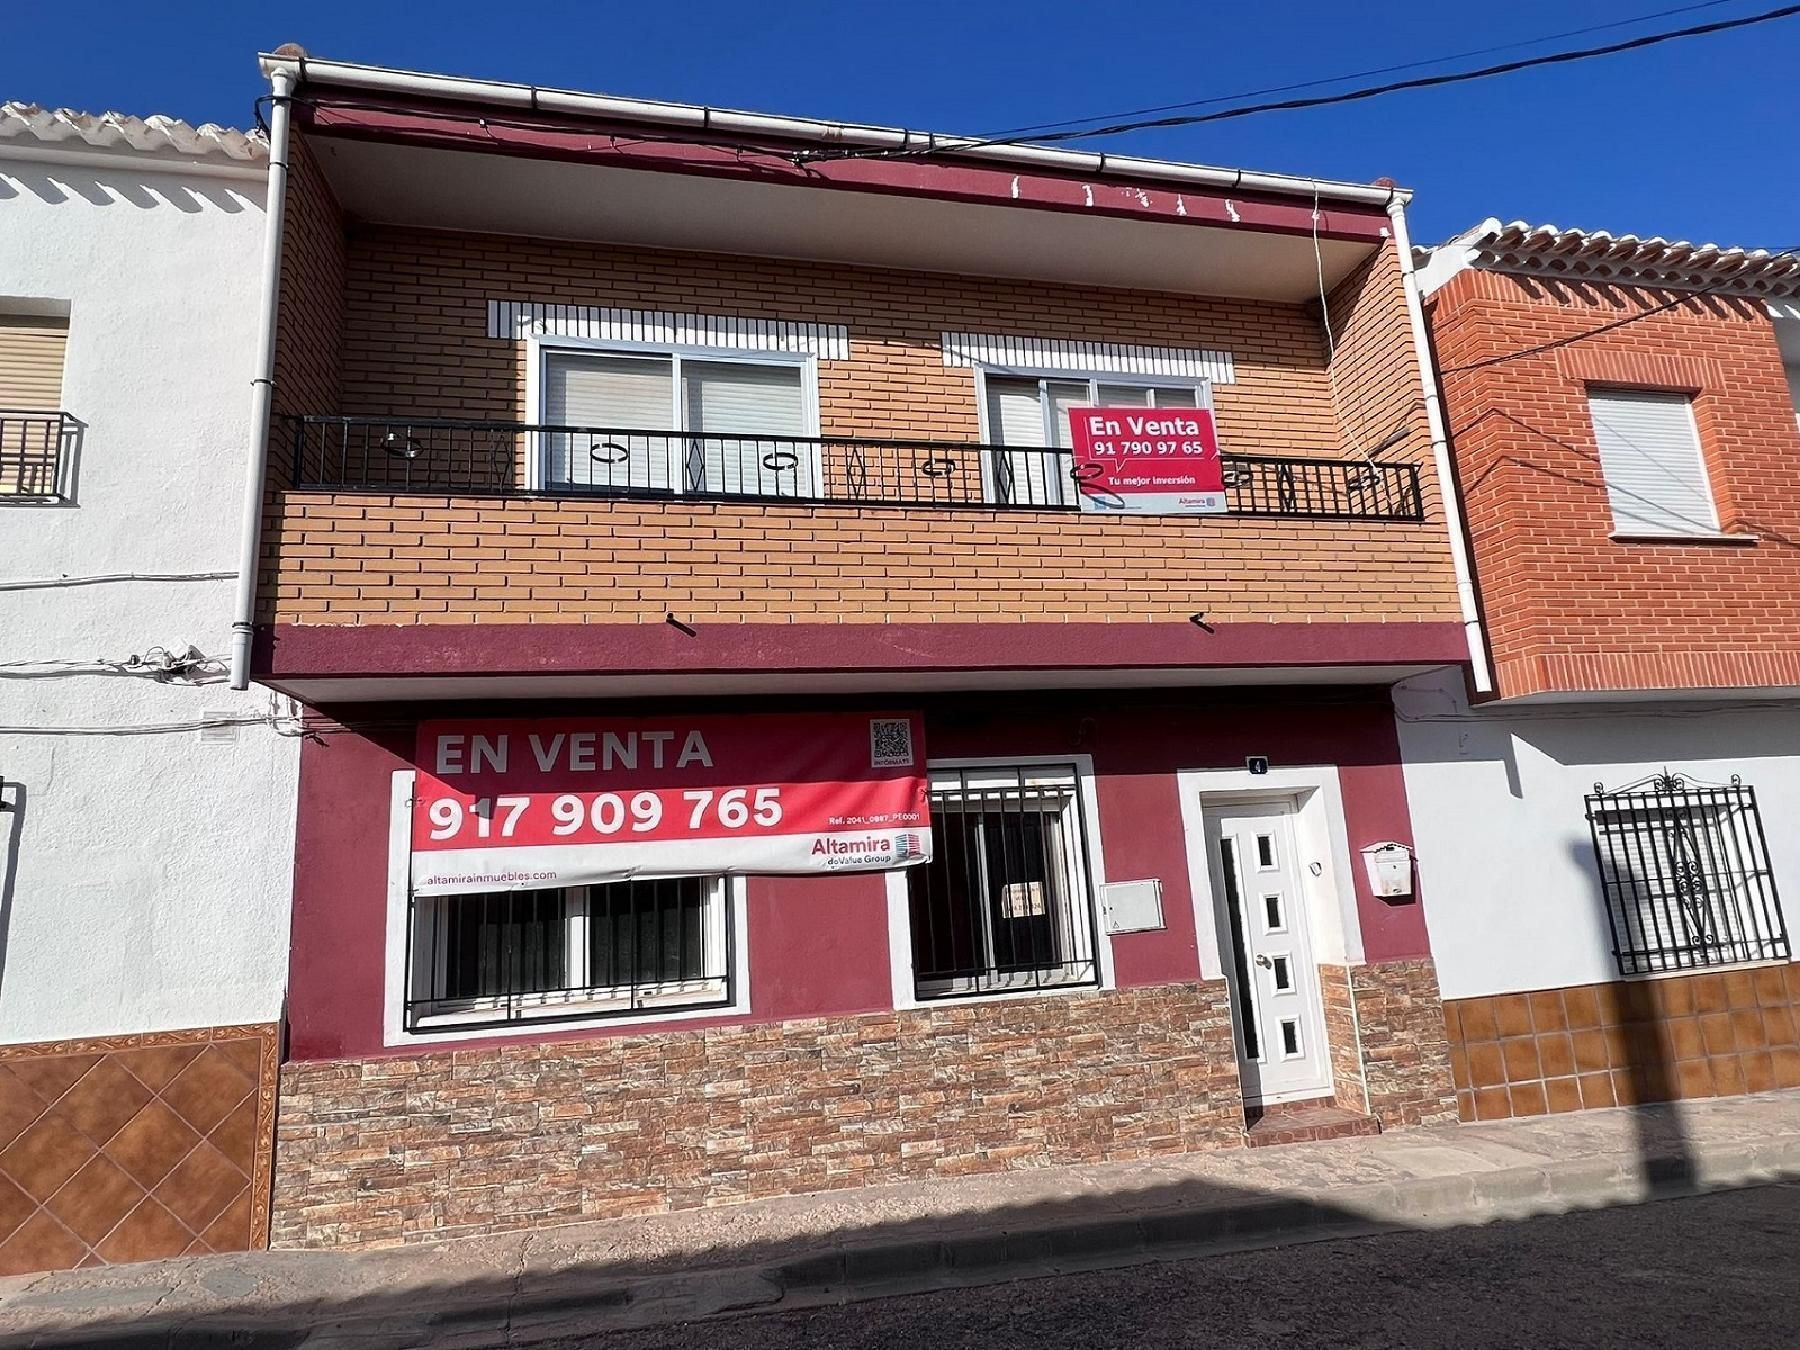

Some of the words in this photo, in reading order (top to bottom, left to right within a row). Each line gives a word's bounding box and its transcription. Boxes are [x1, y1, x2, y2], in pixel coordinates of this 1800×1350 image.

[1089, 416, 1121, 436] En
[1126, 415, 1199, 436] Venta
[1094, 441, 1116, 456] 91
[1121, 441, 1152, 455] 790
[1157, 441, 1177, 454] 97
[1182, 441, 1203, 454] 65
[1108, 476, 1120, 486] Tu
[1123, 476, 1150, 487] mejor
[436, 735, 509, 774] EN
[528, 730, 713, 772] VENTA
[429, 796, 531, 840] 917
[551, 792, 663, 835] 909
[683, 787, 783, 829] 765
[828, 816, 846, 825] Ref.
[811, 835, 890, 856] Altamira
[827, 856, 862, 865] doValue
[864, 855, 891, 863] Group
[427, 871, 557, 885] altamirainmuebles.com
